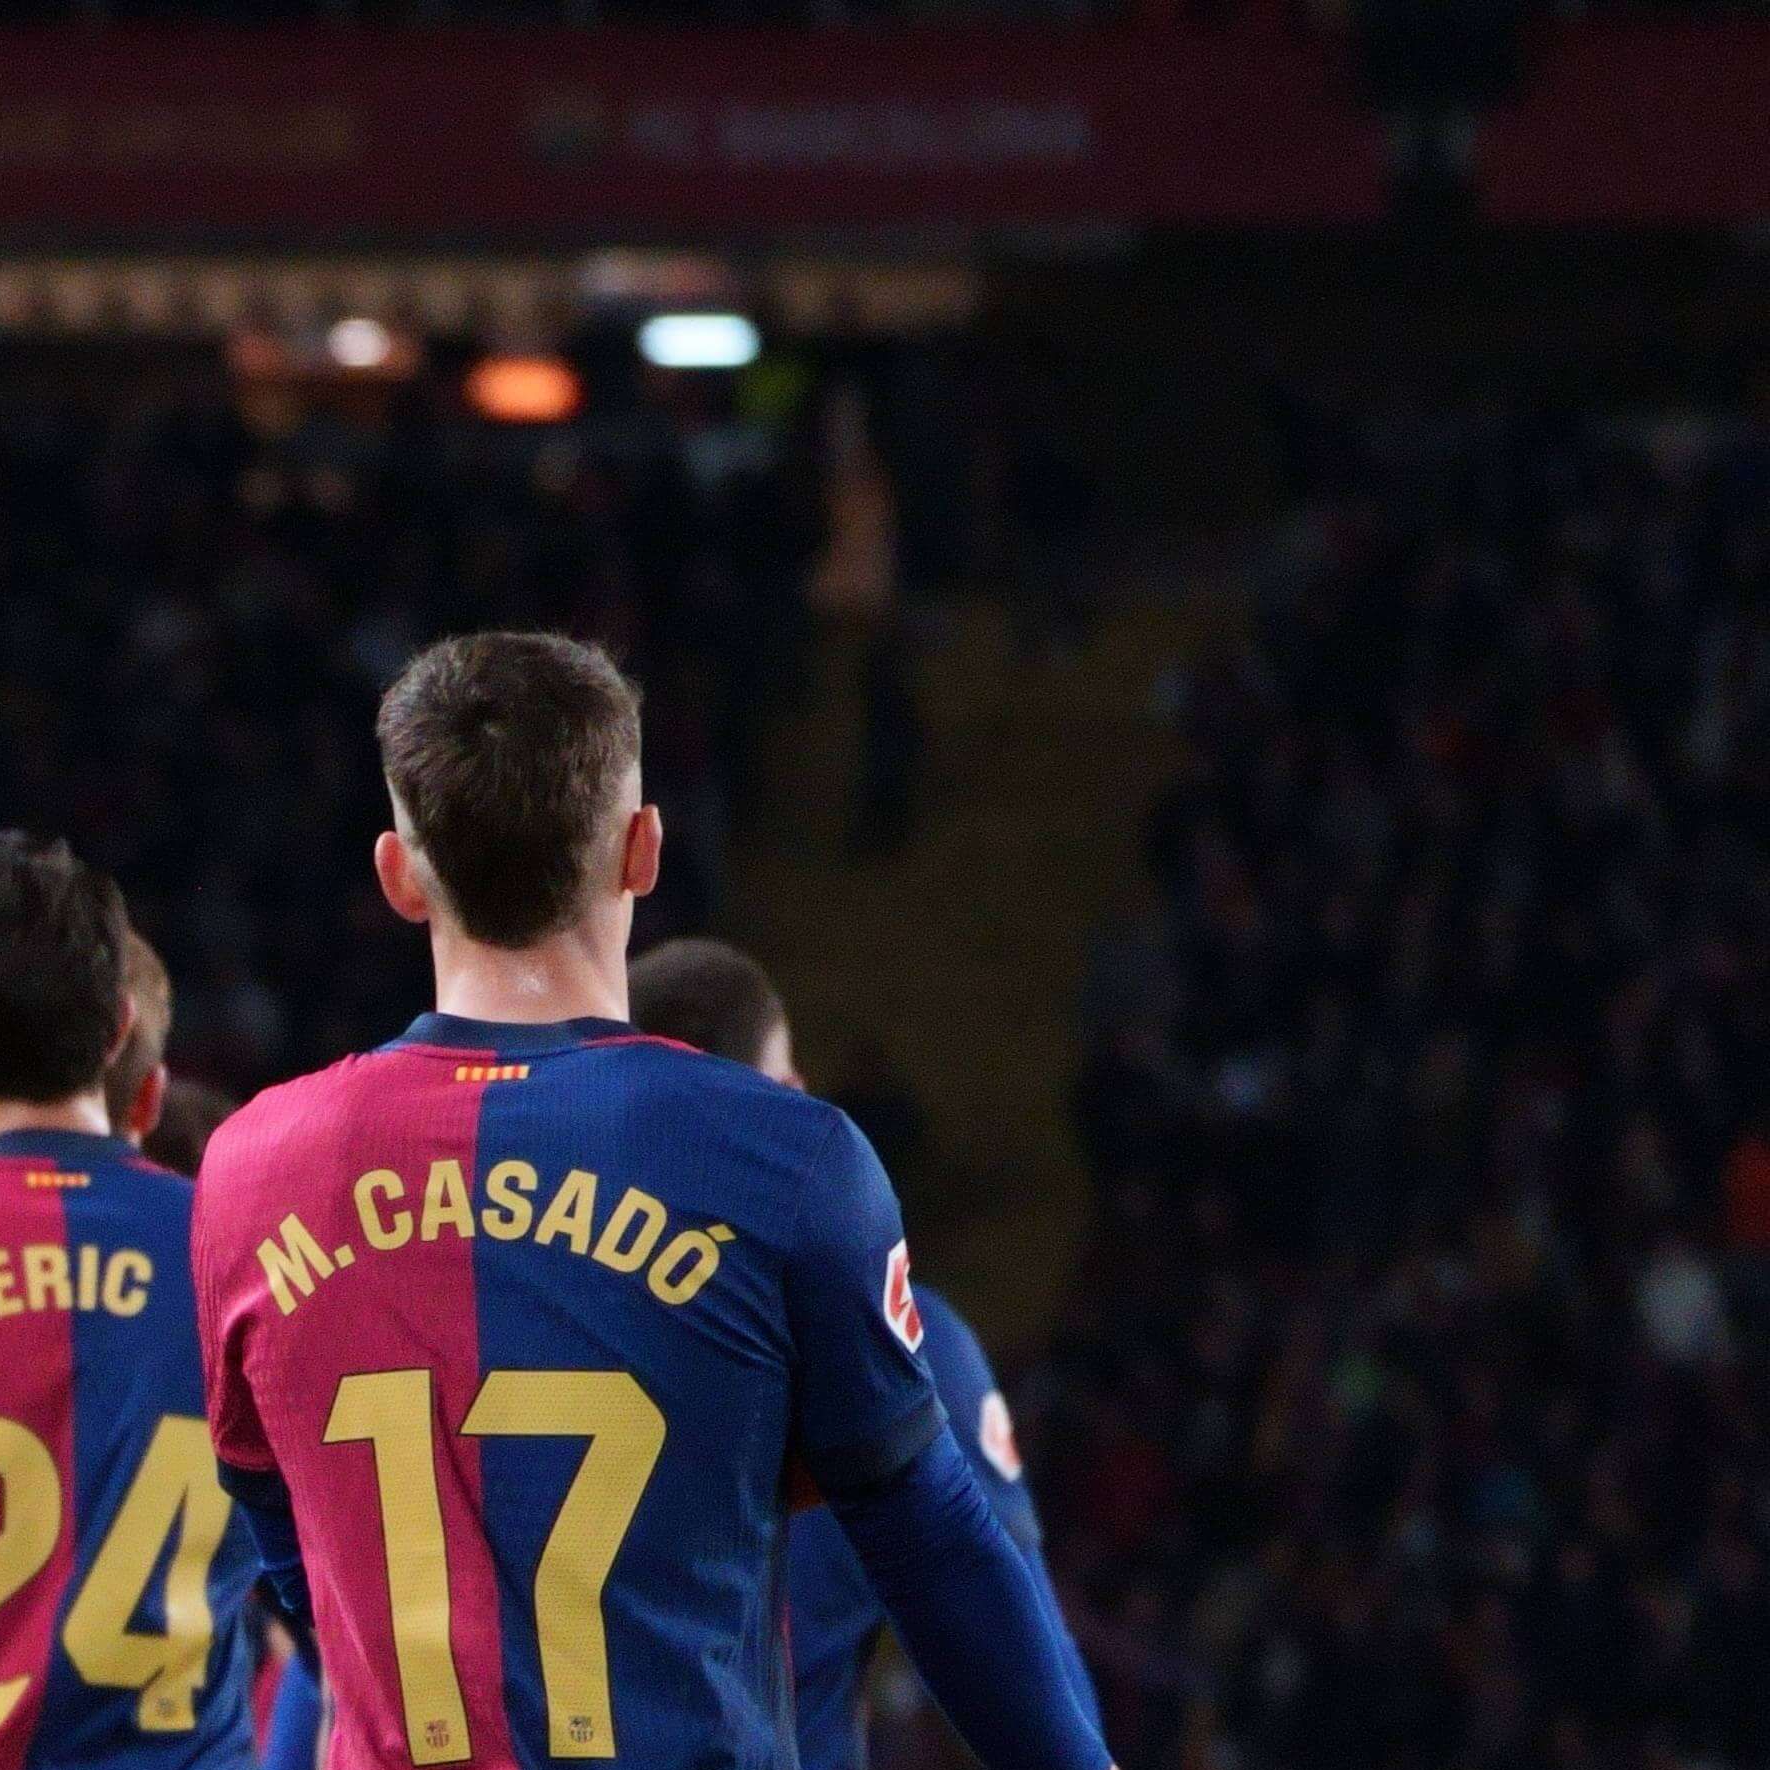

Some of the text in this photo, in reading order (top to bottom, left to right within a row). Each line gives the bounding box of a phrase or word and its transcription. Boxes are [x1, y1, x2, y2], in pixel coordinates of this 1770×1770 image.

[257, 1158, 737, 1316] M. CASADÓ
[322, 1368, 668, 1767] 17
